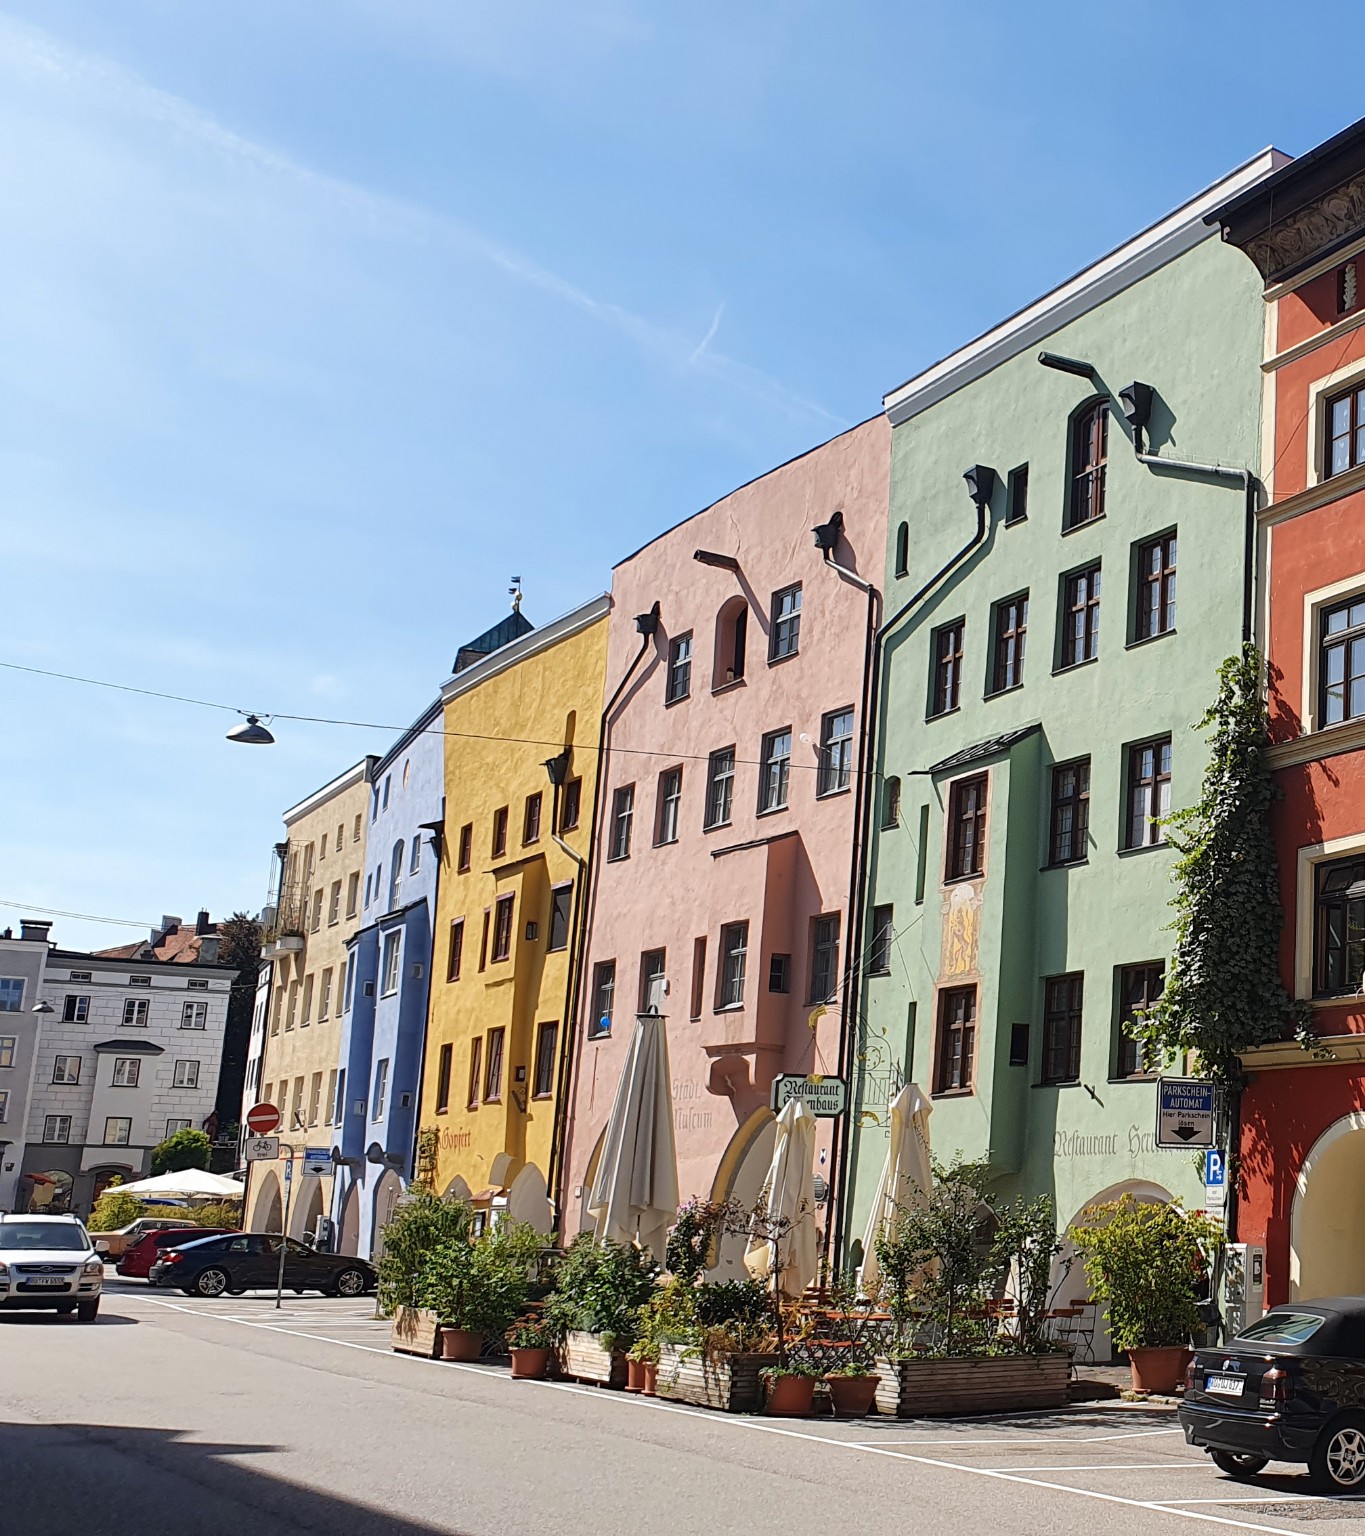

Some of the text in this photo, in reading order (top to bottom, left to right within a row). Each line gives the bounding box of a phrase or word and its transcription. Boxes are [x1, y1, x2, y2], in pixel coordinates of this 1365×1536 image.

[783, 1080, 840, 1096] Restaurant
[1163, 1085, 1211, 1097] PARKSCHEIN-
[1170, 1098, 1203, 1109] AUTOMAT
[1053, 1129, 1118, 1161] Restaurant
[1210, 1154, 1220, 1181] P
